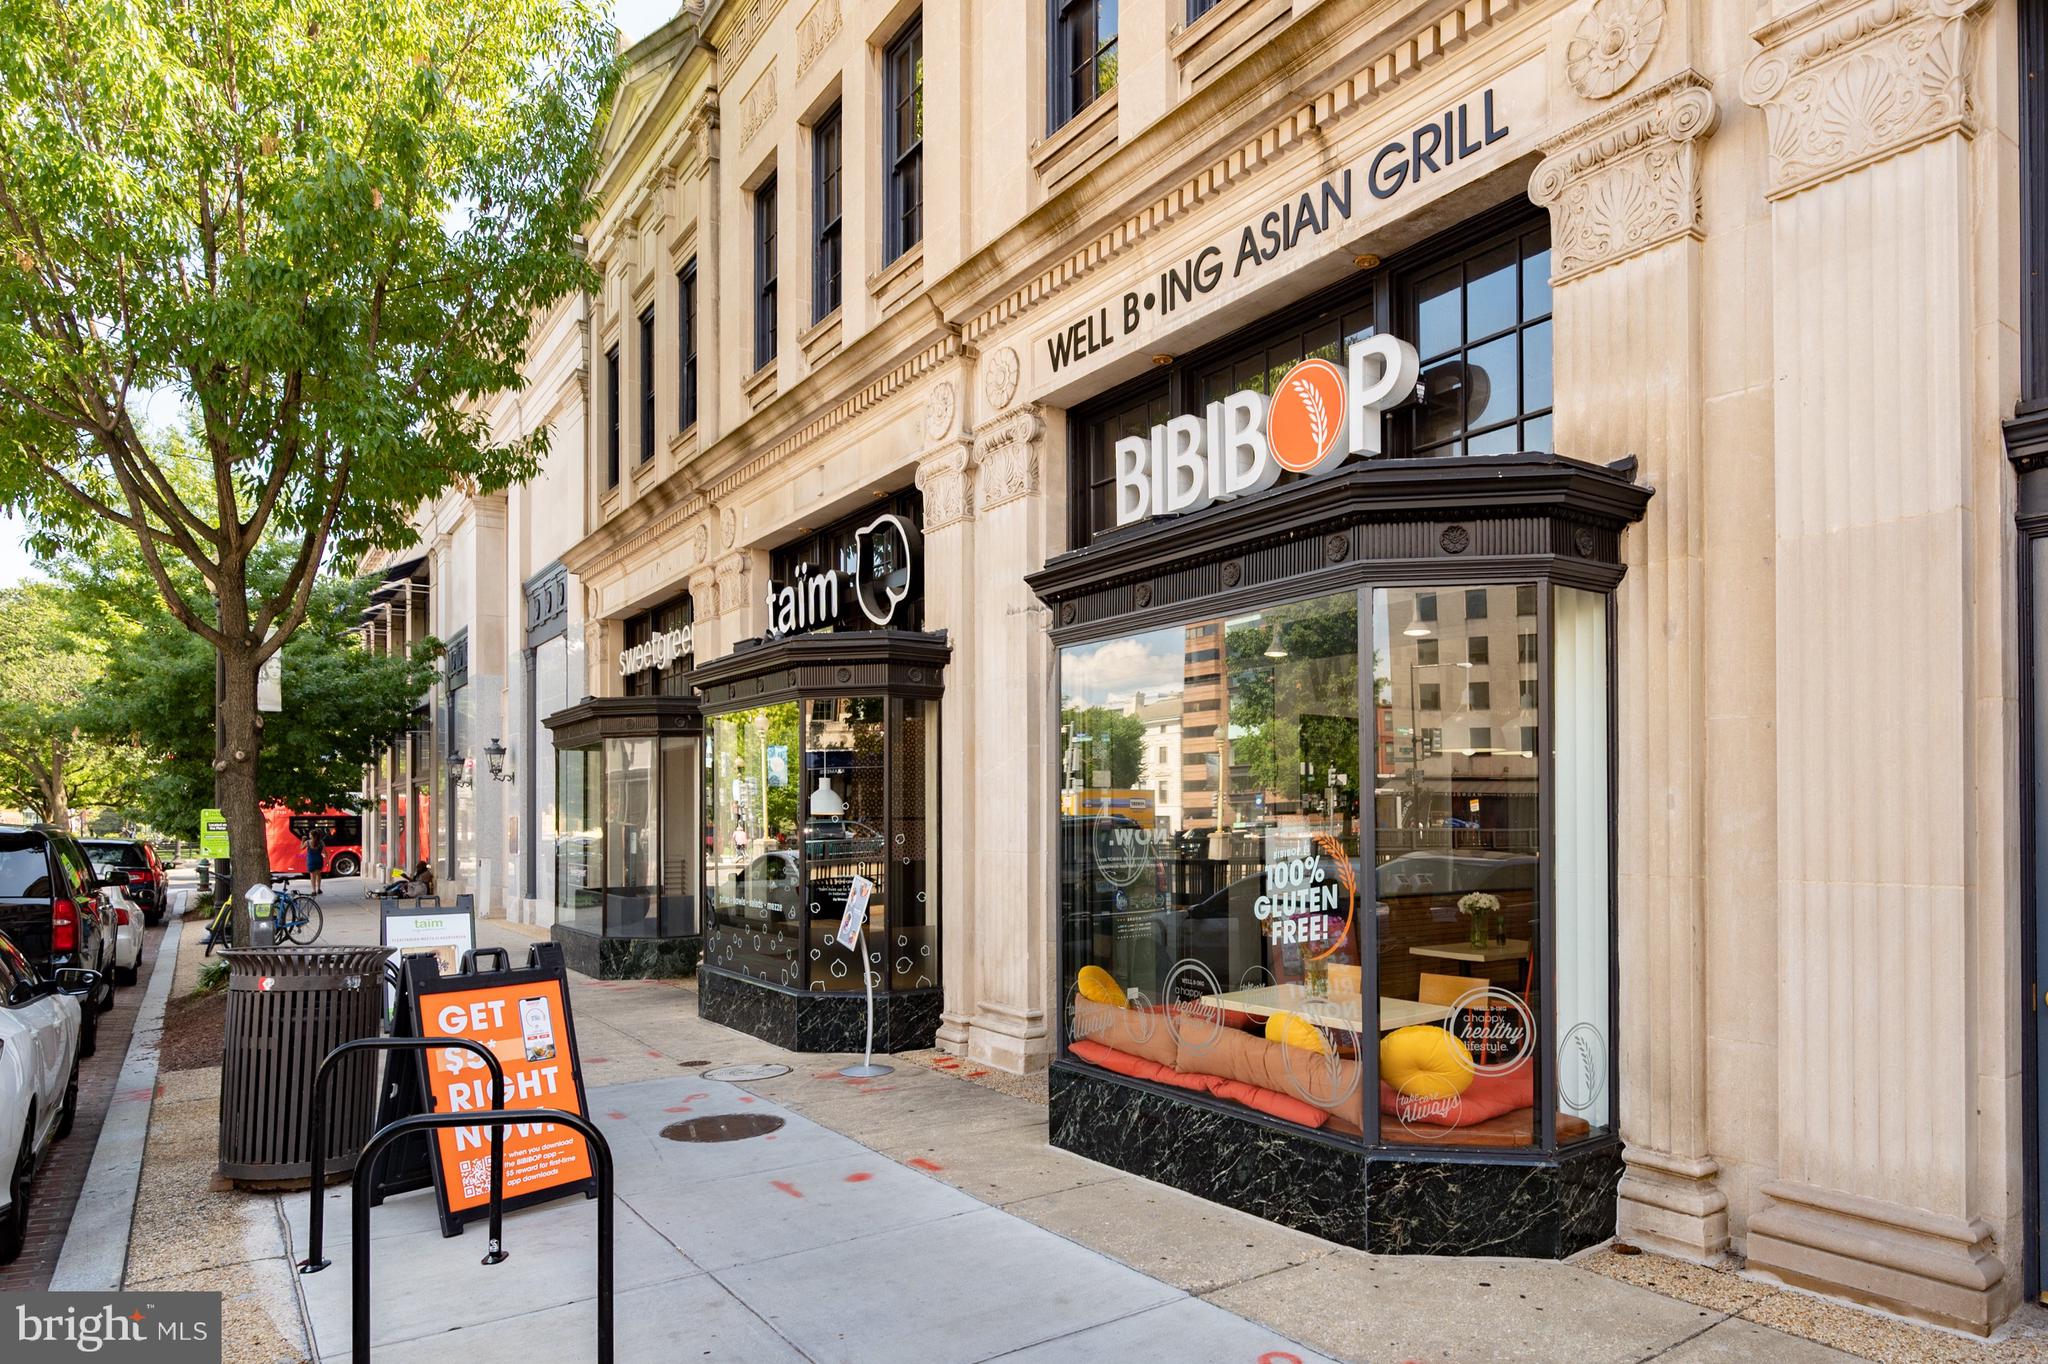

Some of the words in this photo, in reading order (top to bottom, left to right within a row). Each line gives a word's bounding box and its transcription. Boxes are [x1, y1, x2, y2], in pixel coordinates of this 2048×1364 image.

[1048, 308, 1114, 372] WELL
[1233, 169, 1351, 277] ASIAN
[1368, 88, 1509, 199] GRILL
[1115, 333, 1419, 527] BIBIBOP
[619, 624, 694, 676] sweetgree
[1265, 855, 1325, 890] 100%
[1254, 884, 1338, 920] GLUTEN
[1272, 914, 1328, 945] FREE!
[438, 1000, 506, 1035] GET
[1460, 1022, 1524, 1044] healthy
[1463, 1014, 1470, 1023] a
[448, 1066, 558, 1113] RIGHT
[1401, 1095, 1460, 1122] Always
[509, 1150, 527, 1158] when
[541, 1137, 574, 1150] download
[517, 1154, 542, 1165] BIBIBOP
[543, 1152, 556, 1160] app
[507, 1178, 521, 1186] app
[522, 1169, 558, 1182] downloads
[516, 1164, 538, 1174] reward
[549, 1156, 576, 1166] first-time
